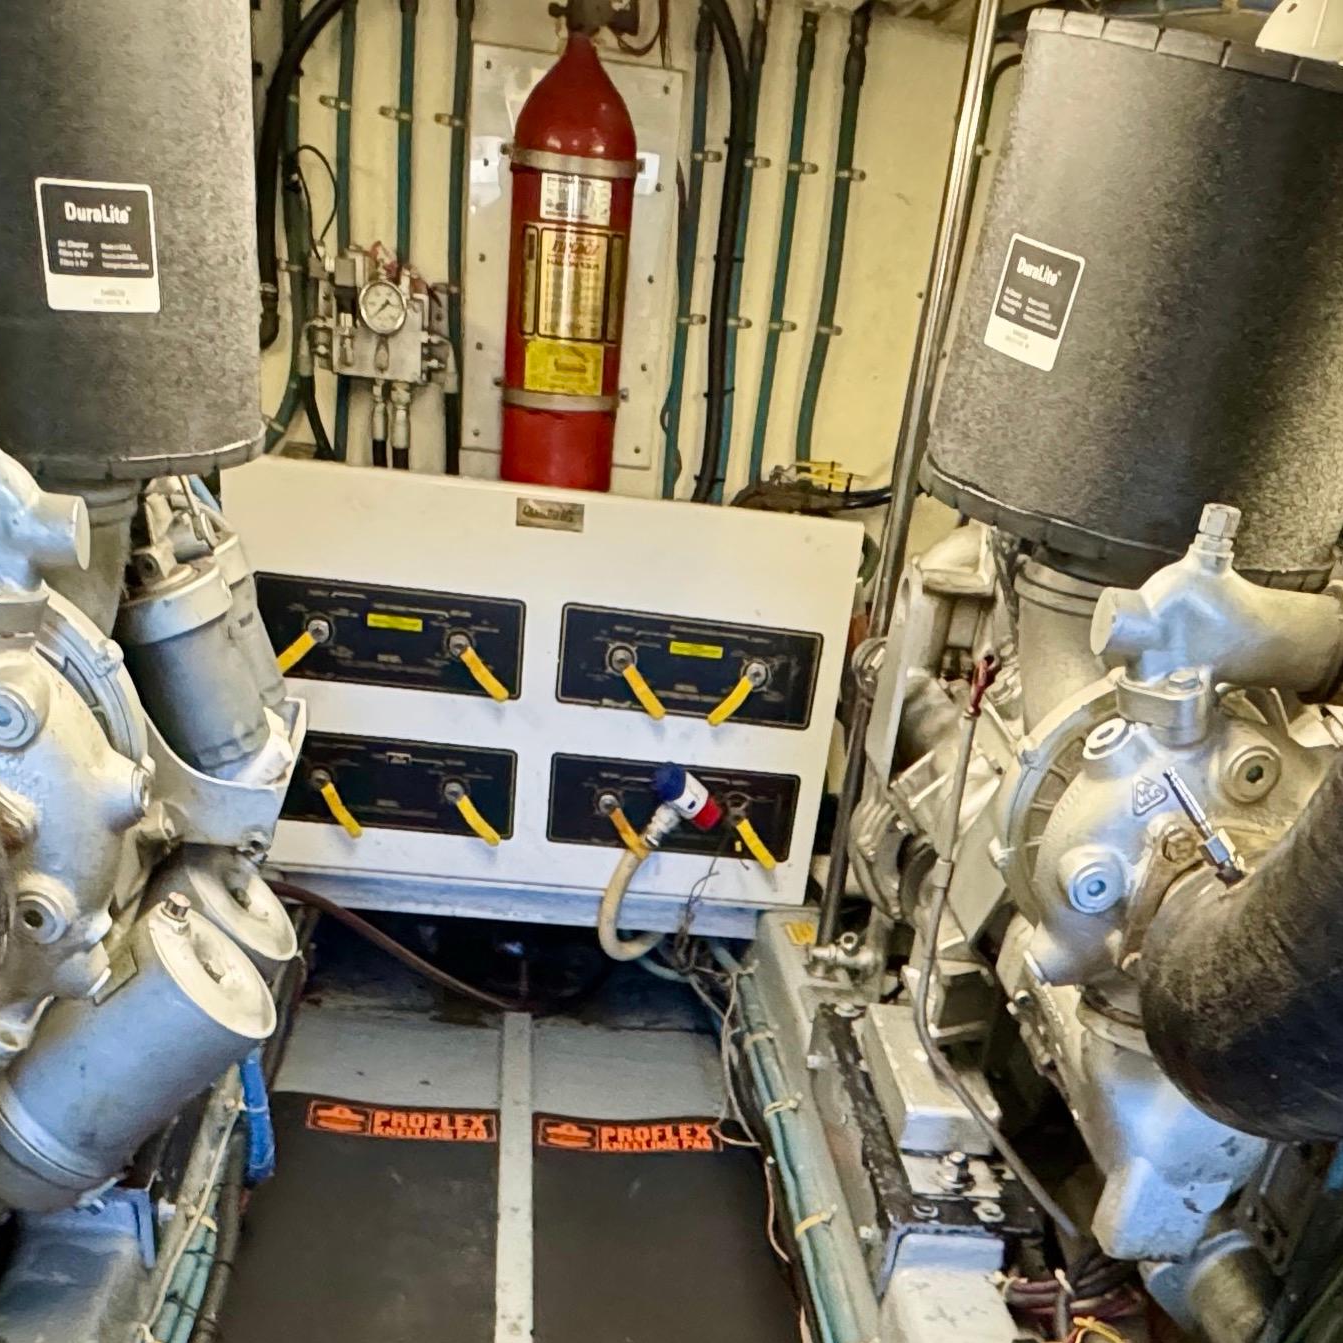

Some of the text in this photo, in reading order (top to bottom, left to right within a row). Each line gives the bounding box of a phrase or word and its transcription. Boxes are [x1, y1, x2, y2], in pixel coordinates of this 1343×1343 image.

[64, 201, 129, 225] DuraLite
[373, 1110, 486, 1130] PROFLEX
[600, 1124, 711, 1143] PROFLEX
